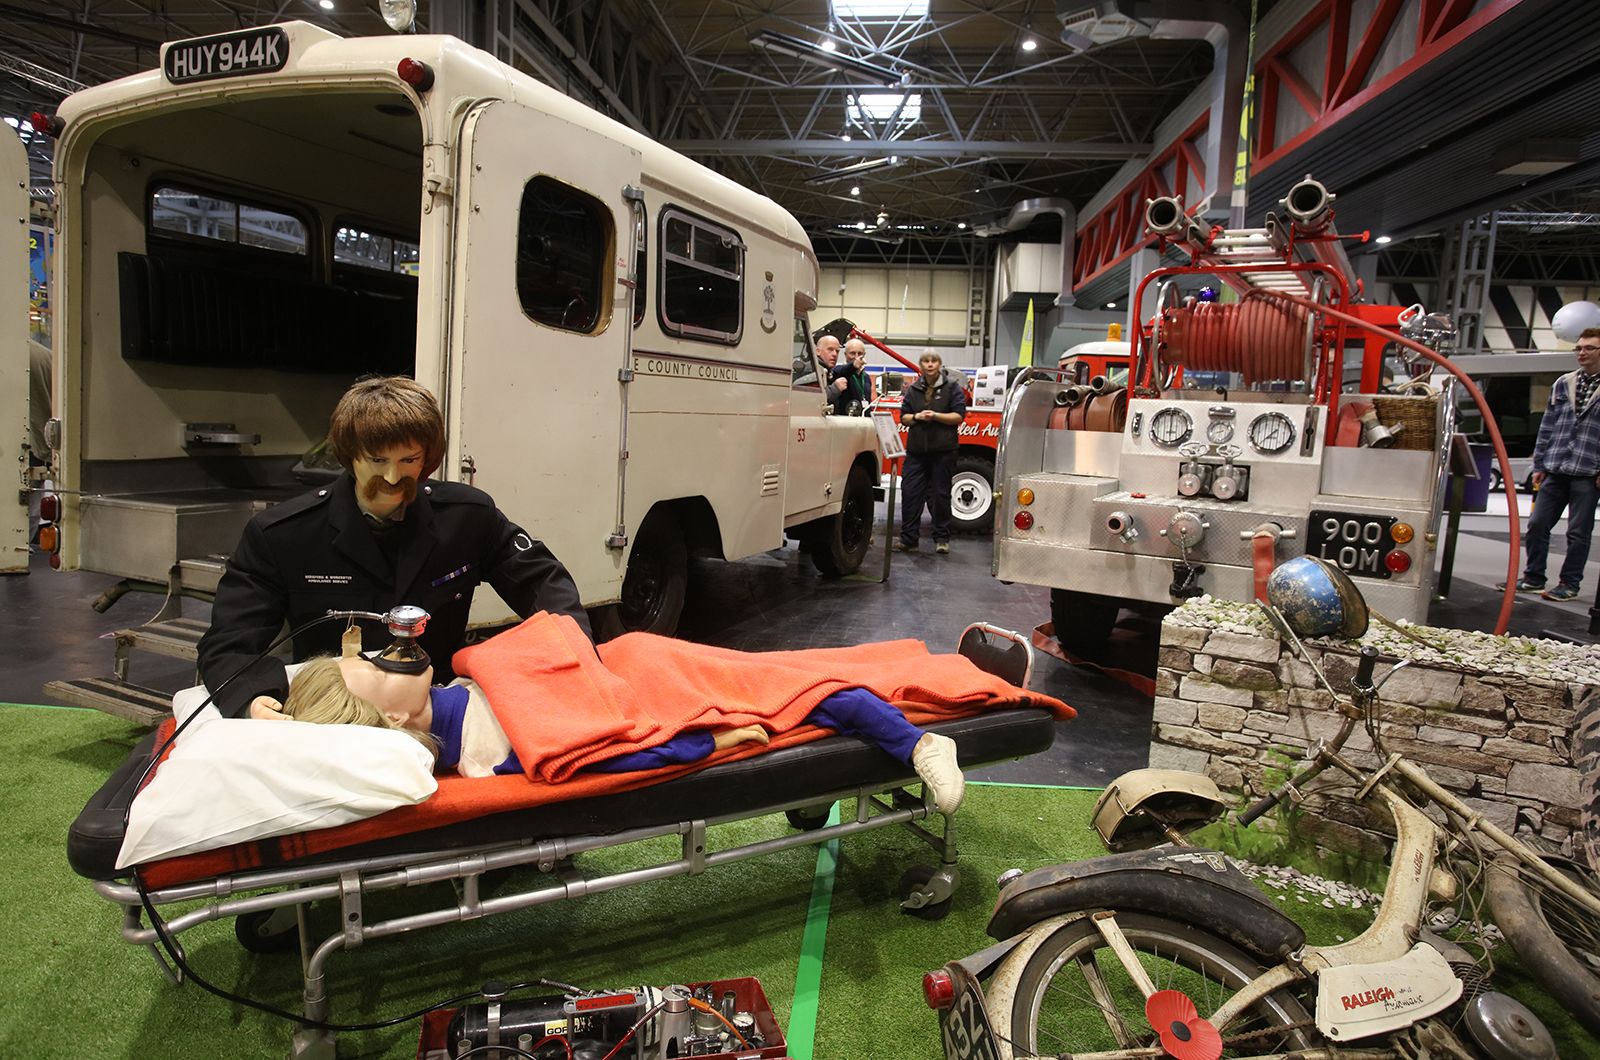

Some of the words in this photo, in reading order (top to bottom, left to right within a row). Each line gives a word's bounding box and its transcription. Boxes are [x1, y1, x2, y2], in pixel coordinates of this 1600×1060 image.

[648, 359, 692, 376] COUNTY
[698, 366, 738, 381] COUNCIL
[797, 428, 806, 443] 53
[1322, 518, 1382, 544] 900
[1206, 855, 1225, 870] R
[1341, 986, 1395, 1011] RALEIGH
